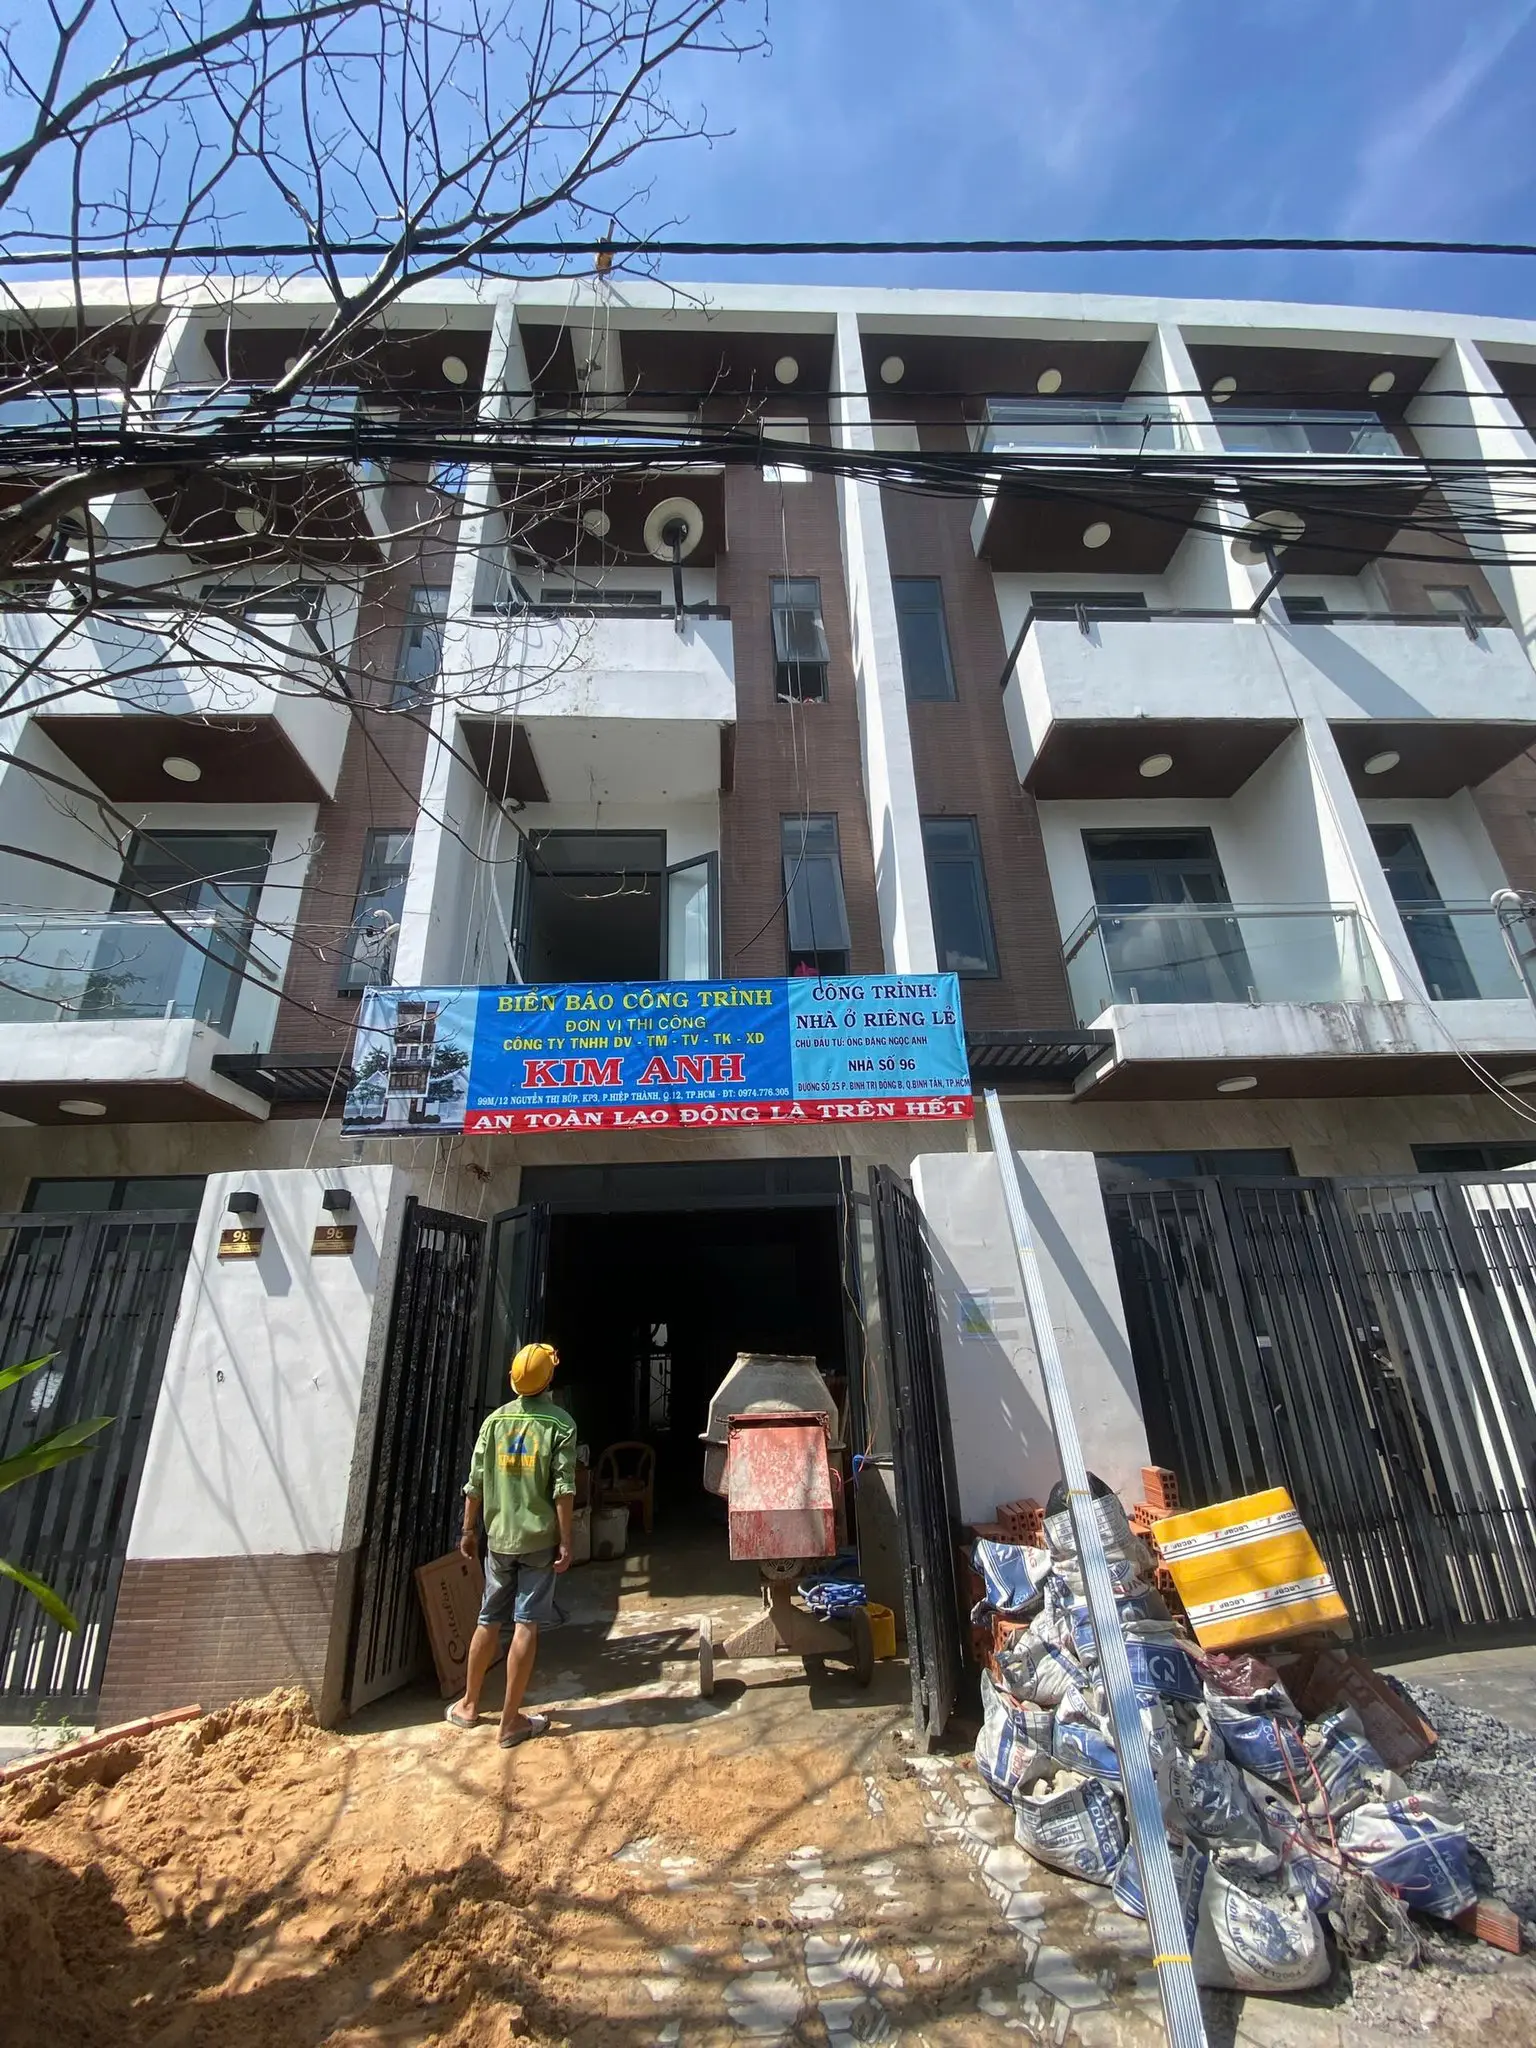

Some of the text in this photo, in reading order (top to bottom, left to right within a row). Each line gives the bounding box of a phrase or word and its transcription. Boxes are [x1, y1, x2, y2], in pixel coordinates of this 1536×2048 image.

[497, 986, 773, 1012] BIỂN BÁO CÔNG TRÌNH
[813, 981, 938, 1001] CÔNG TRÌNH:
[565, 1014, 706, 1034] ĐƠN VỊ THI CÔNG
[796, 1005, 956, 1029] NHÀ Ở RIÊNG LẺ
[503, 1035, 543, 1051] CÔNG
[547, 1038, 566, 1050] TY
[570, 1037, 608, 1049] TNHH
[614, 1036, 632, 1048] DV
[647, 1035, 668, 1047] TM
[681, 1034, 699, 1046] TV
[713, 1033, 732, 1045] TK
[746, 1032, 765, 1044] XD
[911, 1035, 928, 1045] ANH
[521, 1053, 745, 1089] KIM ANH
[848, 1054, 916, 1072] NHÀ SỐ 96
[832, 1081, 841, 1091] 25
[545, 1094, 560, 1105] THỊ
[602, 1091, 629, 1102] P.HIỆP
[686, 1090, 715, 1099] TP.HCM
[722, 1089, 736, 1098] ĐT:
[738, 1087, 789, 1098] 0974.776.305
[471, 1096, 966, 1130] AN TOÀN LAO ĐỘNG LÀ TRÊN HẾT
[232, 1230, 250, 1242] 98
[326, 1227, 344, 1239] 96
